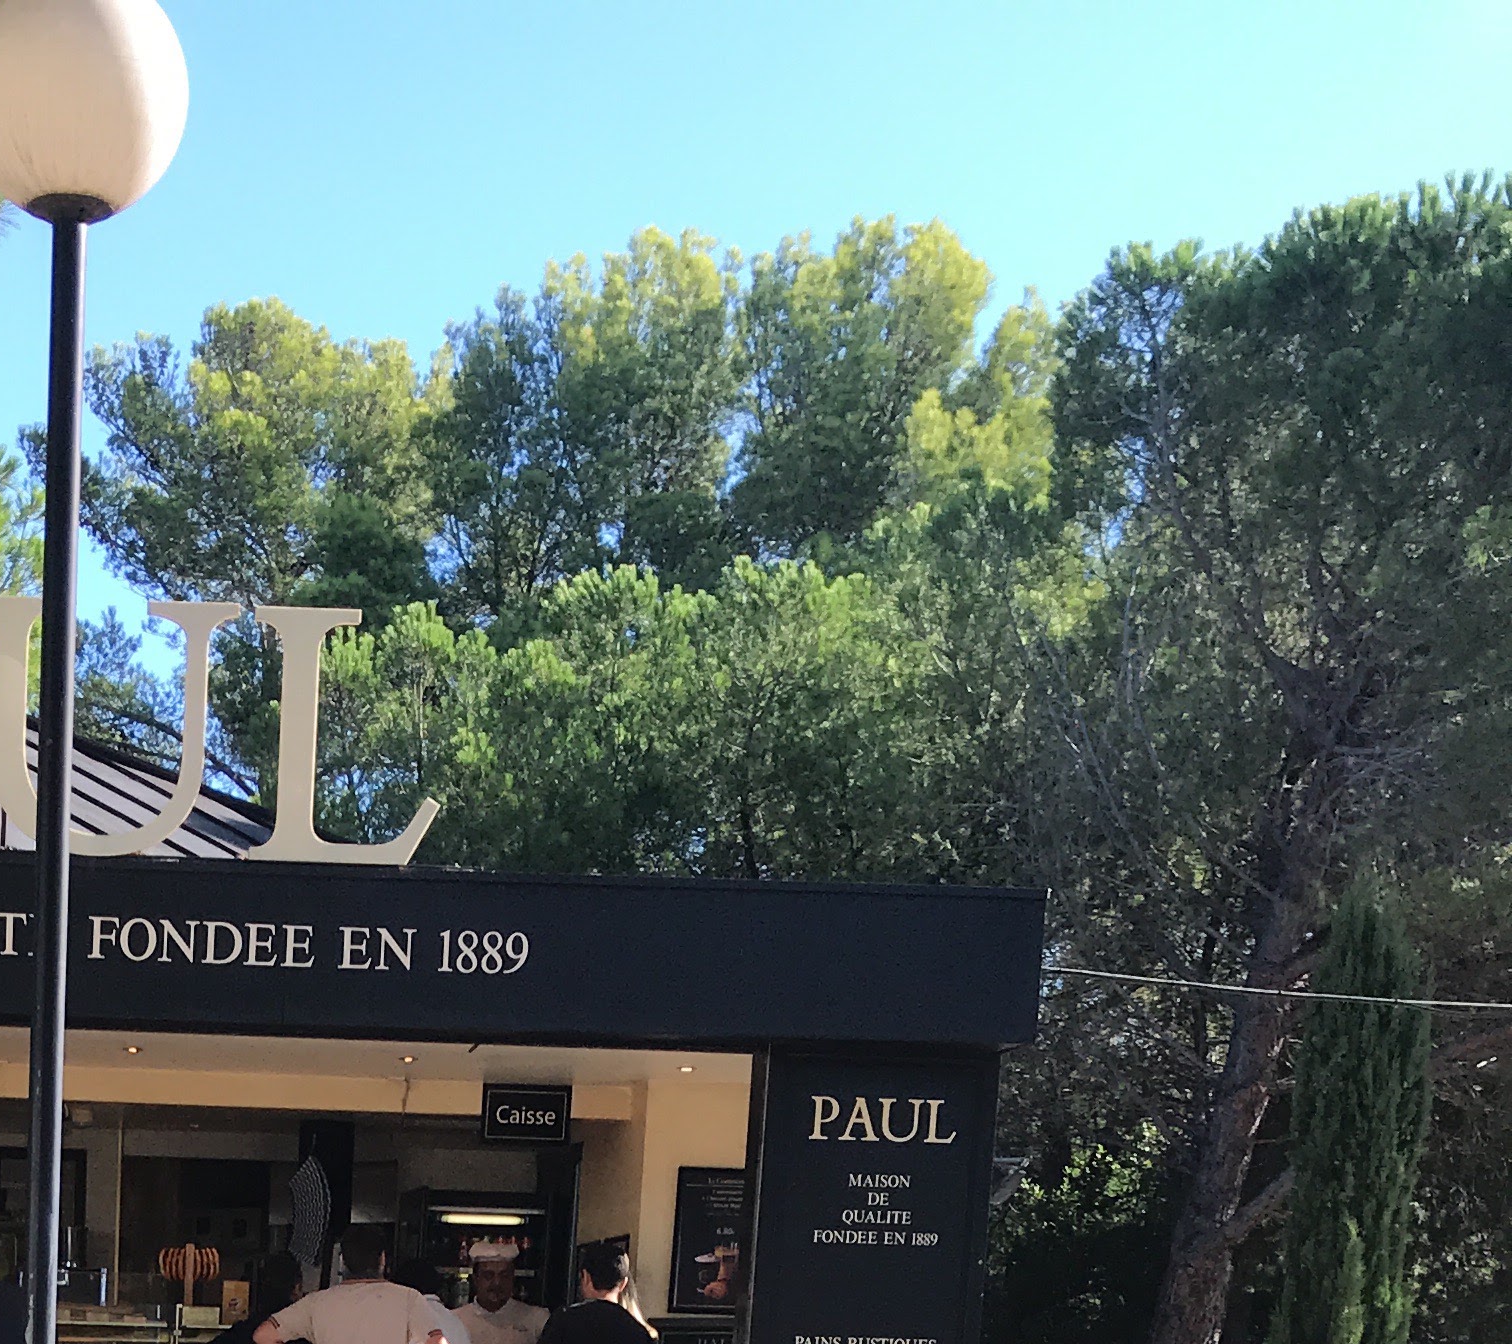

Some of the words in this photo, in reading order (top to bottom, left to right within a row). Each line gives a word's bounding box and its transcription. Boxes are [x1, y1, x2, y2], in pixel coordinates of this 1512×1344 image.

[88, 916, 314, 967] FONDEE
[338, 927, 417, 970] EN
[438, 930, 528, 974] 1889
[496, 1106, 555, 1125] Caisse
[809, 1096, 956, 1143] PAUL
[849, 1174, 910, 1187] MAISON
[868, 1192, 888, 1205] DE
[842, 1210, 910, 1225] QUALITE
[814, 1230, 877, 1244] FONDEE
[884, 1232, 906, 1244] EN
[912, 1233, 938, 1245] 1889
